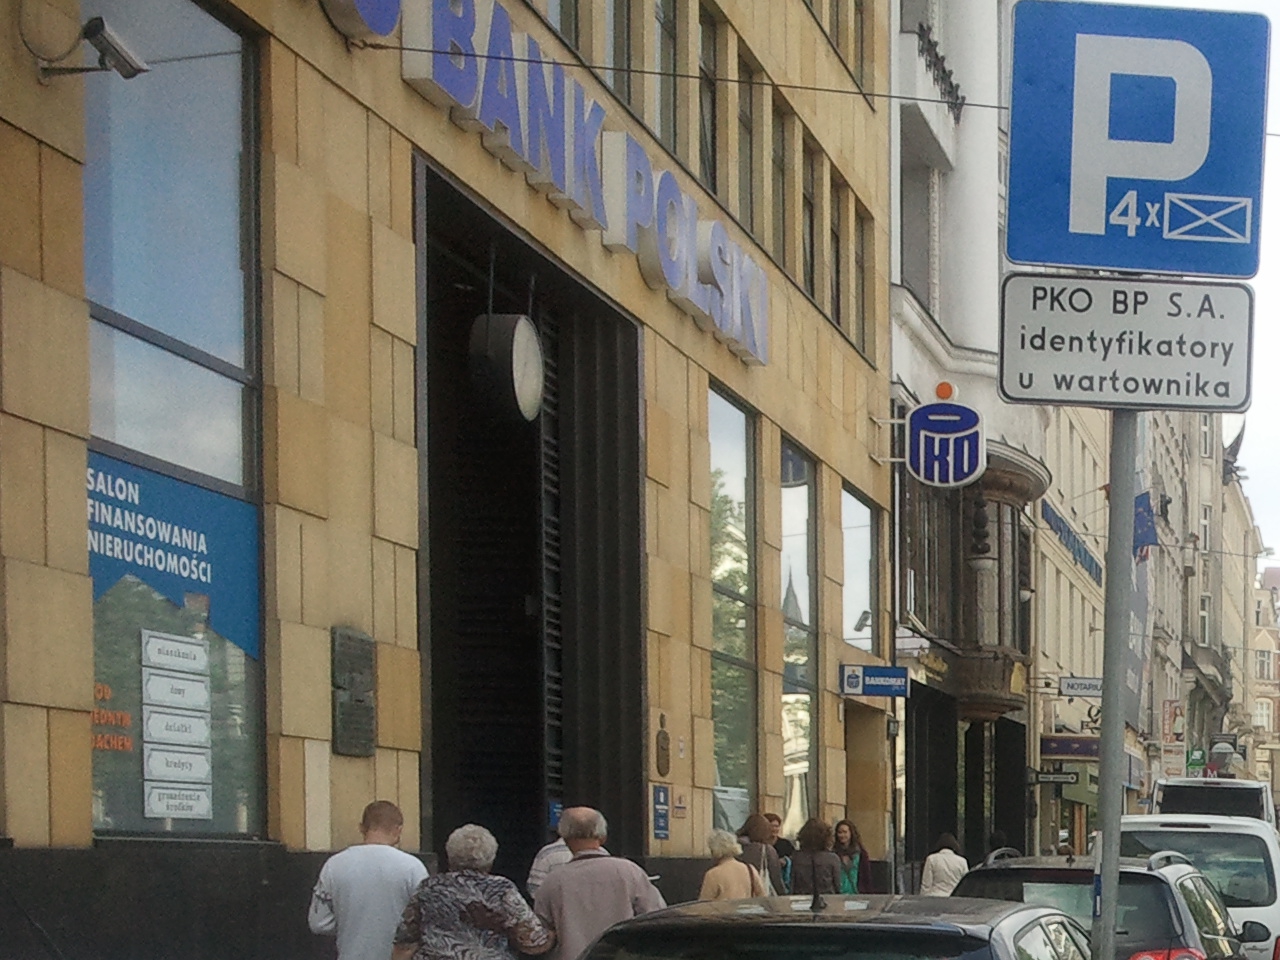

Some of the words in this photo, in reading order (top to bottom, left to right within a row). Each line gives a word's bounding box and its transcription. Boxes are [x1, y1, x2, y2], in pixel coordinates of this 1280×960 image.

[1069, 33, 1212, 235] P
[428, 0, 608, 230] BANK
[622, 131, 768, 366] POLSKI
[1032, 286, 1092, 313] PKO
[1112, 290, 1149, 315] BP
[1167, 292, 1225, 319] S.A.
[1020, 325, 1234, 366] identyfikatory
[1018, 371, 1034, 390] u
[1053, 370, 1231, 398] wartownika
[87, 468, 140, 505] SALON
[87, 498, 208, 555] FINANSOWANIA
[88, 529, 211, 584] NIERUCHOMOŚCI
